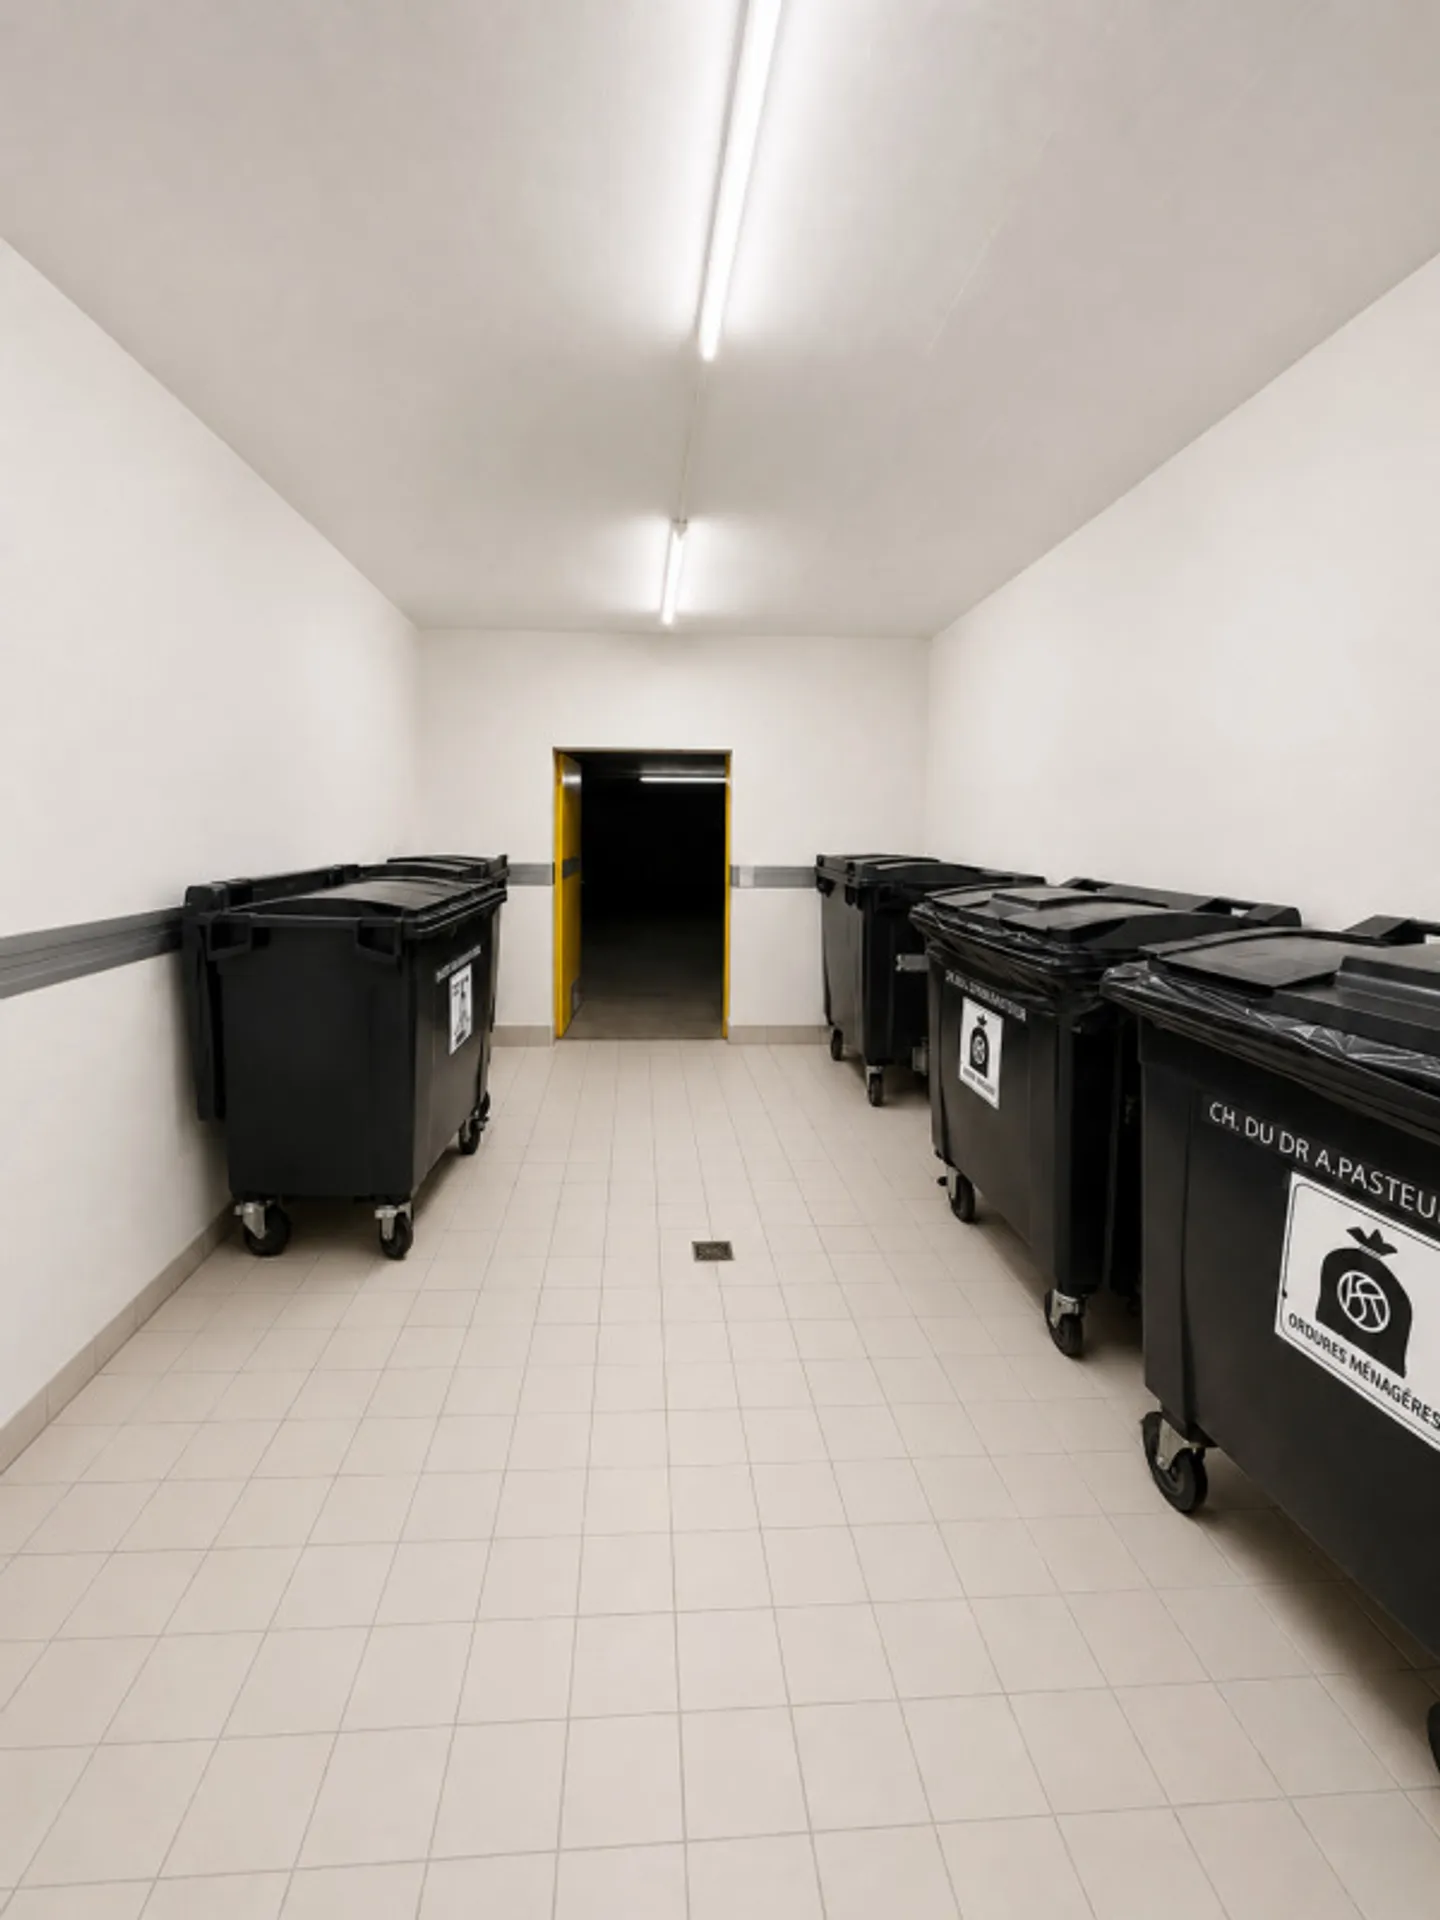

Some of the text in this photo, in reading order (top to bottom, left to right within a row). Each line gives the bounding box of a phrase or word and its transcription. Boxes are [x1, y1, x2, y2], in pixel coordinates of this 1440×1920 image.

[1208, 1101, 1440, 1224] CH. DU DR A.PASTEU
[1288, 1312, 1348, 1365] ORDURES
